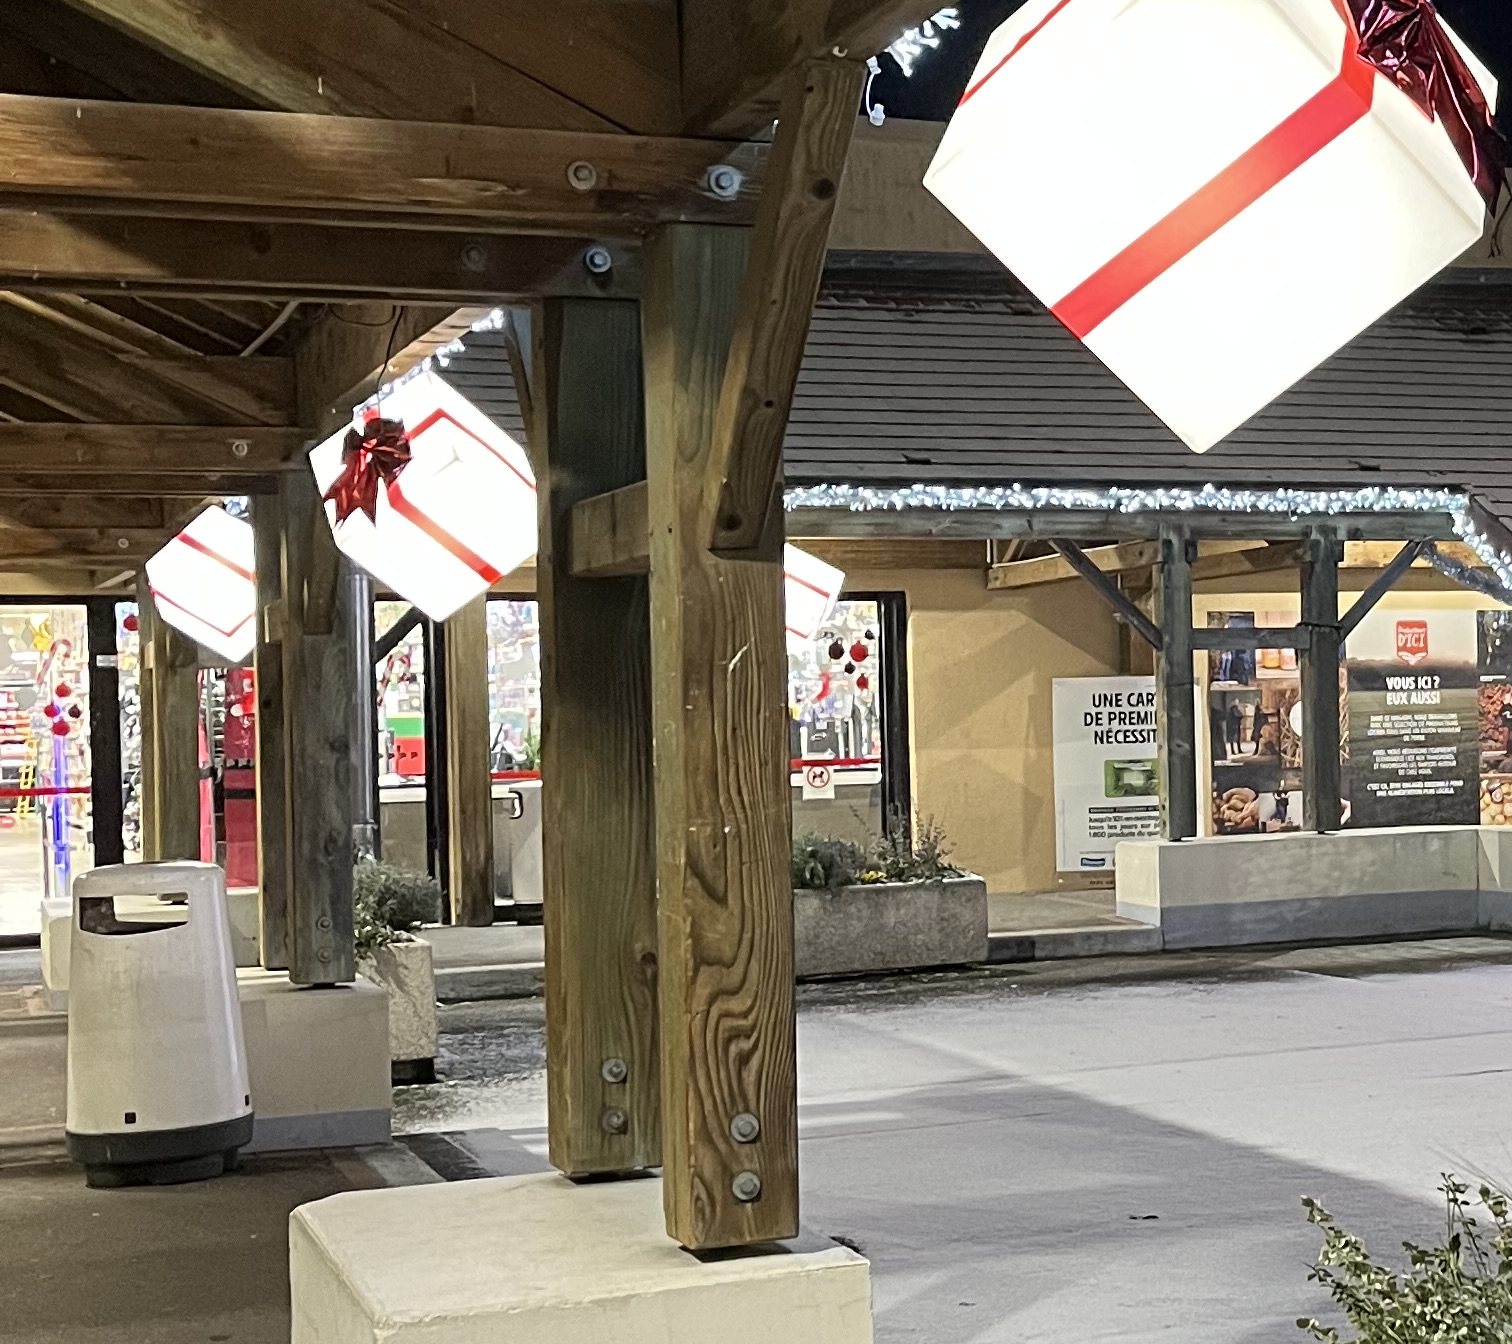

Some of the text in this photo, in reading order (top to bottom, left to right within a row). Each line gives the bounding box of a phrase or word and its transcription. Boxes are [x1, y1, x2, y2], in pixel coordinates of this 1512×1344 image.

[1397, 633, 1426, 647] D'ICI
[1385, 675, 1441, 690] VOUS ICI ?
[1092, 692, 1156, 708] UNE CAR
[1386, 691, 1441, 705] EUX AUSSI
[1084, 712, 1104, 726] DE
